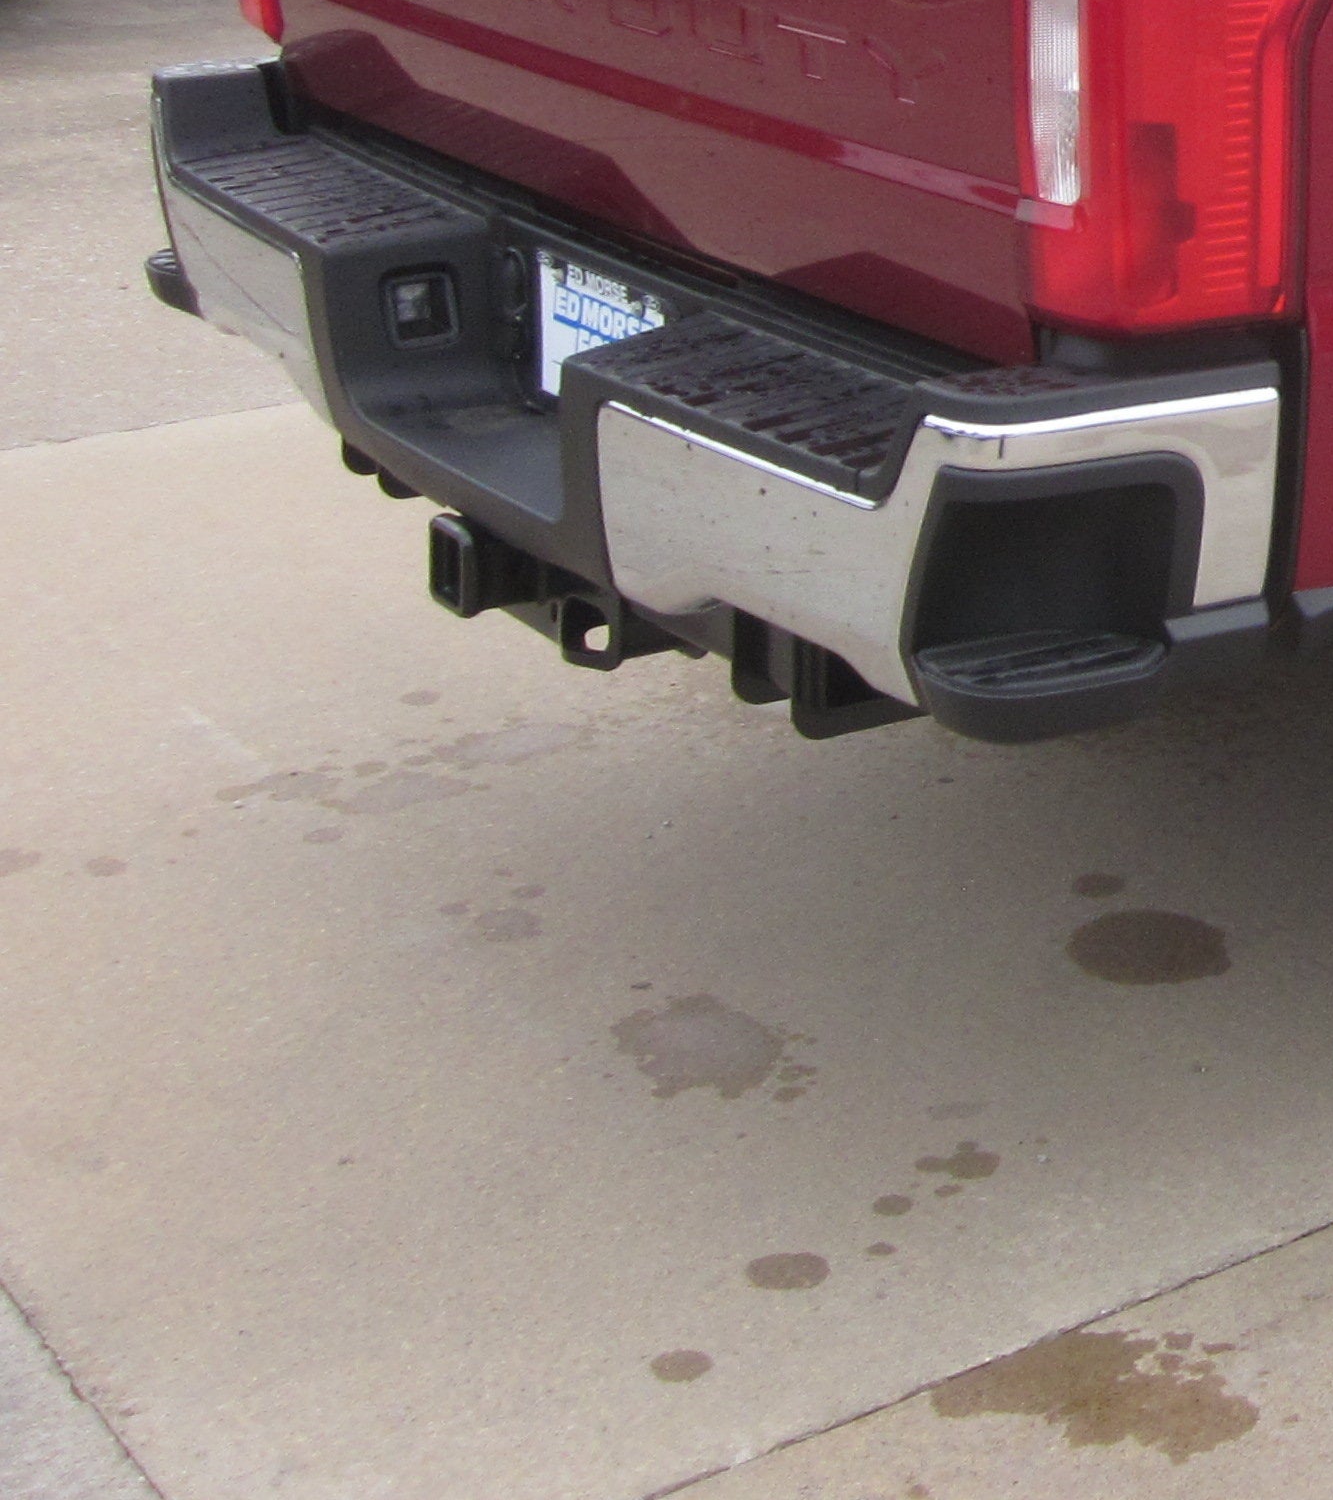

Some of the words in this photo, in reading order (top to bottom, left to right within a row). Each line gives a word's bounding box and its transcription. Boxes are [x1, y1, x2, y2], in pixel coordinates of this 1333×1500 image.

[566, 263, 584, 284] ED
[585, 271, 629, 302] MORSE
[555, 287, 580, 323] ED
